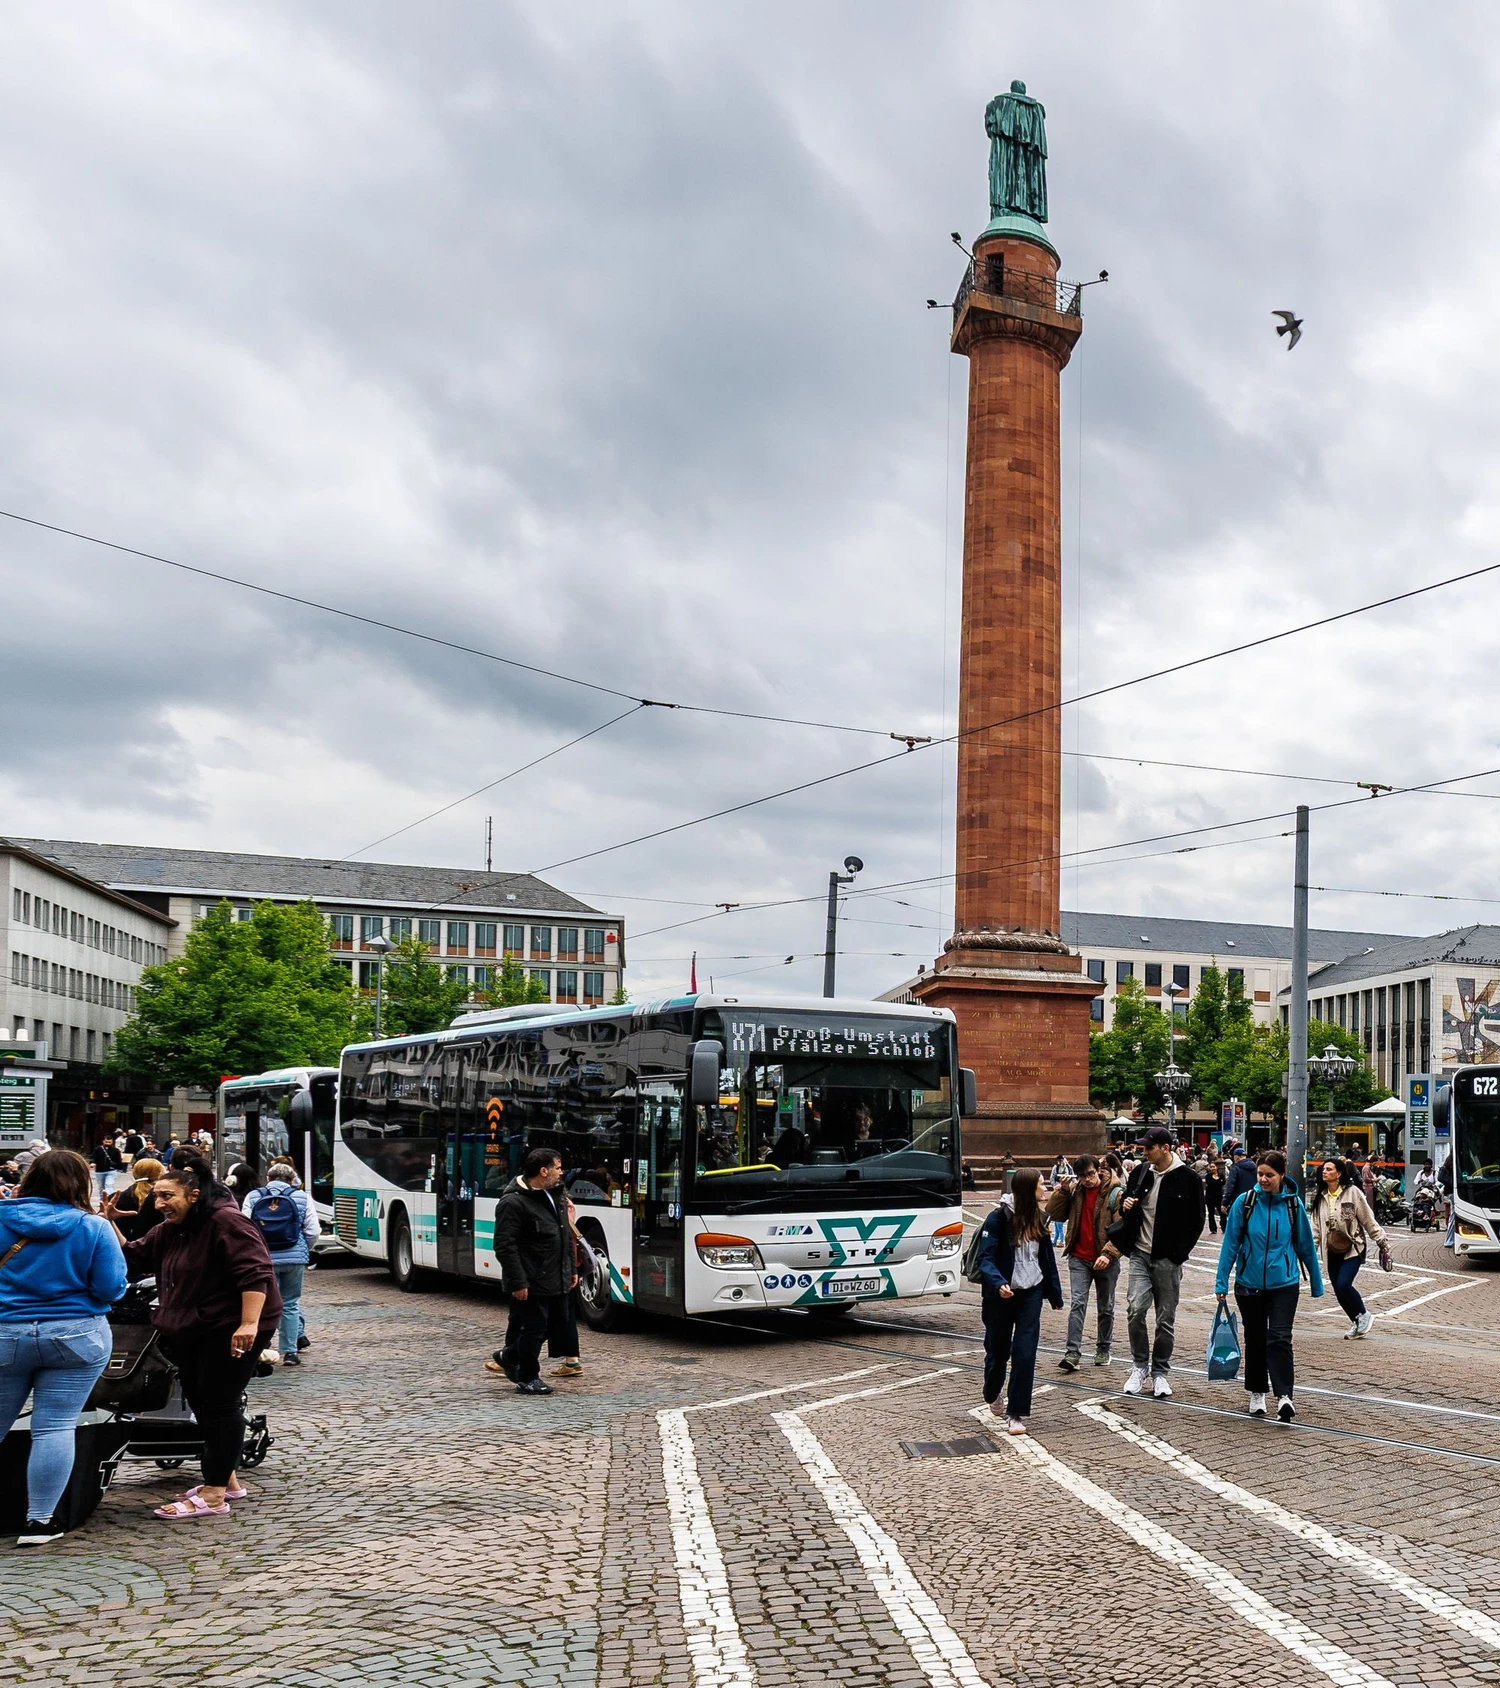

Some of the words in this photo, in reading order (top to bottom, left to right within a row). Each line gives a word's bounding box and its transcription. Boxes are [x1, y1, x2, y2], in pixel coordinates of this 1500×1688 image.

[732, 1022, 766, 1052] X71
[777, 1024, 931, 1044] Groß-Umstadt
[772, 1037, 857, 1054] Pfälzer
[868, 1042, 936, 1059] Schloß
[1473, 1076, 1498, 1095] 672
[1422, 1095, 1428, 1105] 2
[776, 1225, 814, 1236] RMV
[807, 1247, 895, 1260] SETRA
[832, 1282, 844, 1293] DI
[850, 1281, 863, 1292] WZ
[864, 1280, 876, 1290] 60
